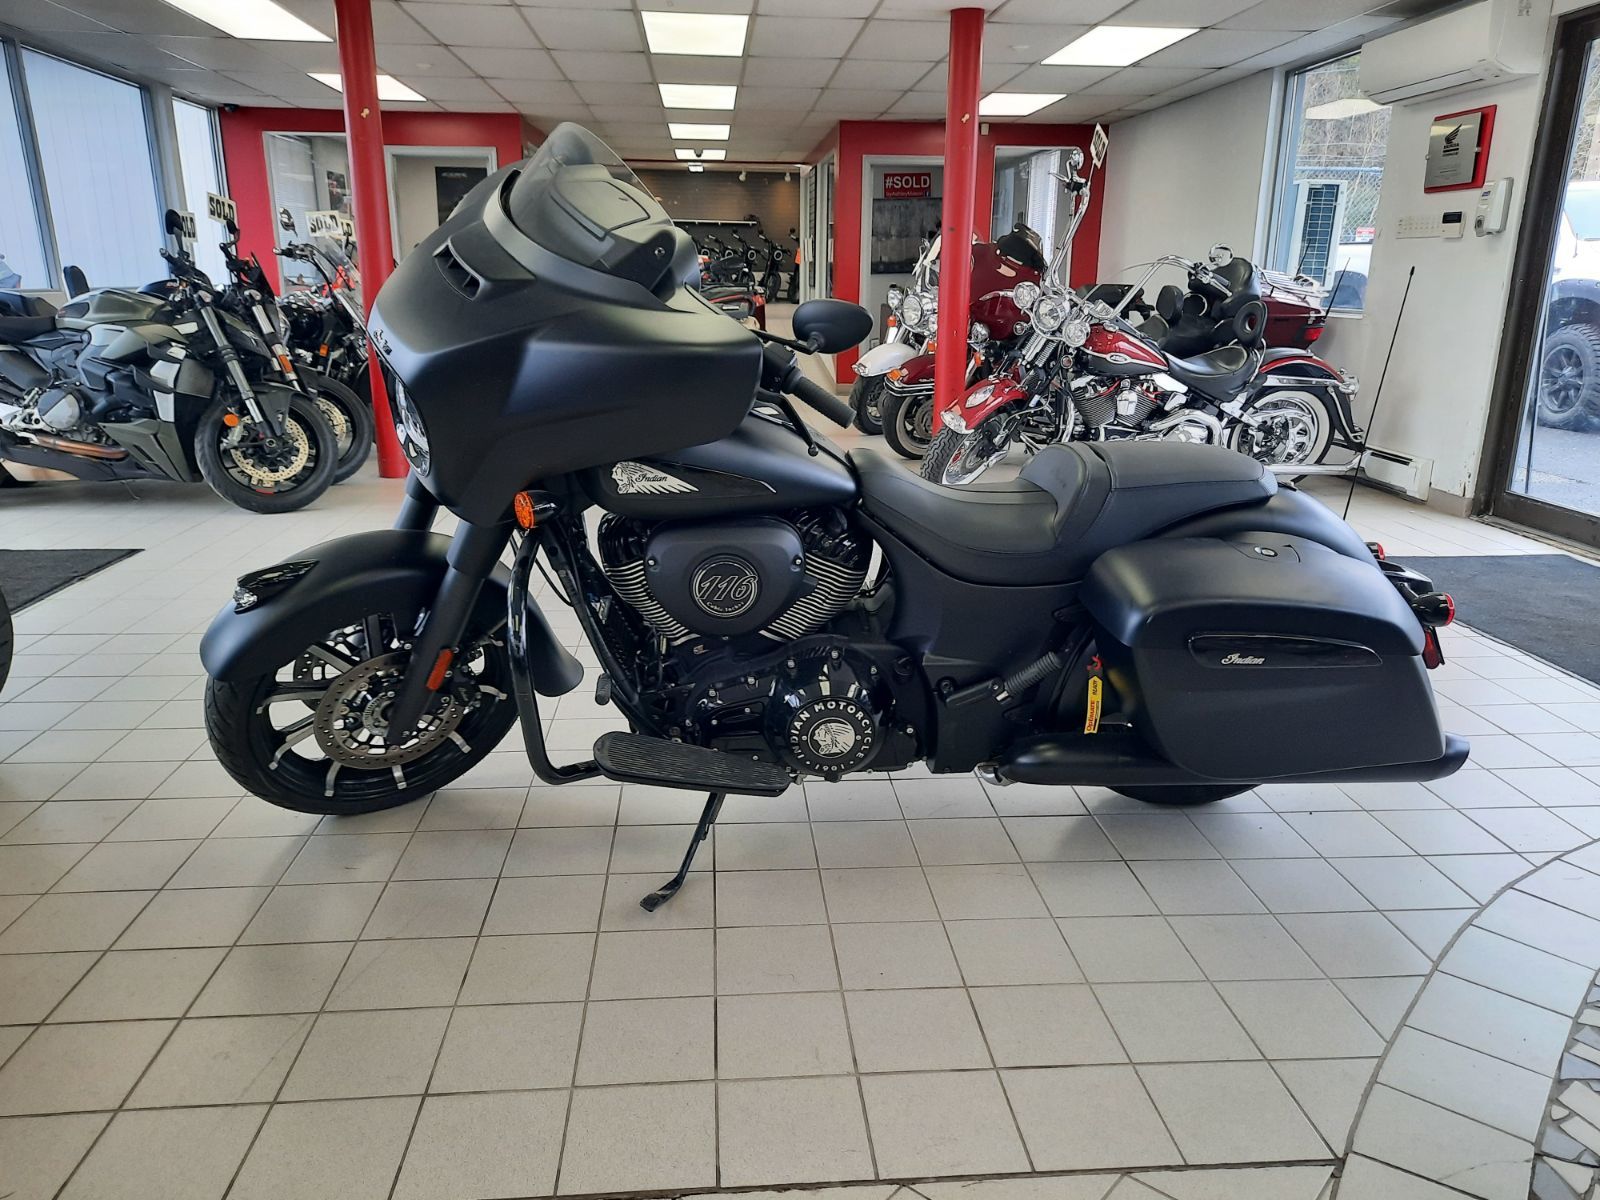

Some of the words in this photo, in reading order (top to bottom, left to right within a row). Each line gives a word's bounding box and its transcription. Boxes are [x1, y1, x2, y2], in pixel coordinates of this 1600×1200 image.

[885, 175, 930, 189] #SOLD
[209, 195, 235, 222] SOLD
[181, 215, 196, 239] OLD
[310, 214, 339, 233] SOLD
[341, 221, 353, 237] LD
[635, 473, 668, 483] Indian
[697, 574, 759, 601] 116
[1220, 653, 1265, 665] Indian
[790, 710, 811, 759] INDIAN
[813, 701, 873, 759] MOTORCYCLE
